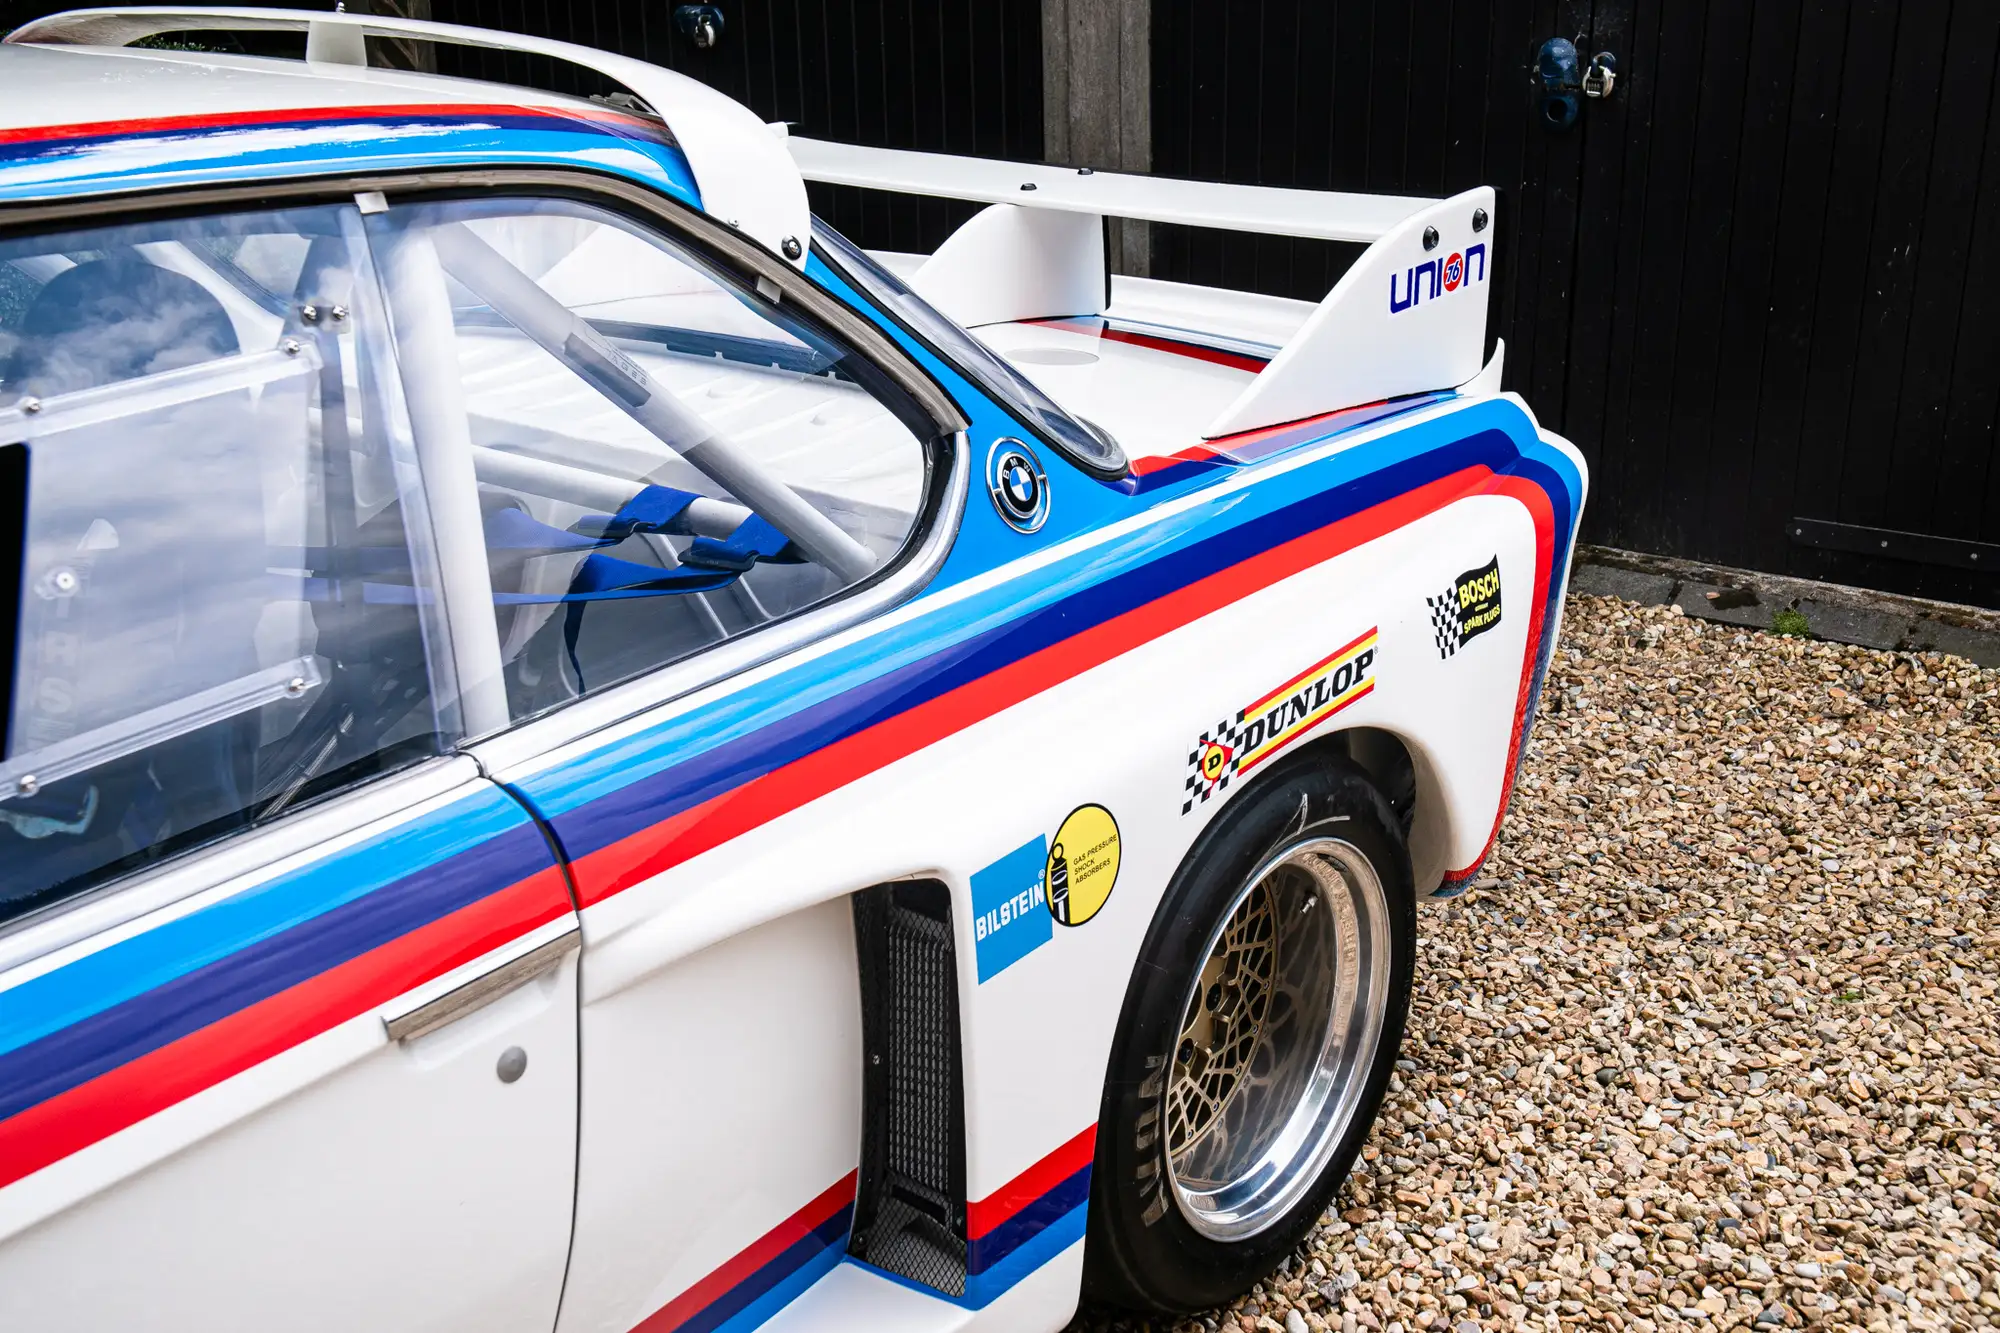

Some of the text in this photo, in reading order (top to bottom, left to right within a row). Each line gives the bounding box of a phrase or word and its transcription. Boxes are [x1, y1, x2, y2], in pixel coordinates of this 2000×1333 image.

[1445, 259, 1461, 285] 76
[1003, 457, 1031, 480] BMW
[1458, 567, 1499, 609] BOSCH
[1464, 614, 1483, 635] SPARK
[1483, 603, 1501, 625] PLUGS
[1240, 647, 1374, 756] DUNLOP
[1207, 753, 1222, 772] D
[1073, 834, 1118, 866] GAS PRESSURE
[1074, 857, 1096, 876] SHOCK
[1075, 857, 1112, 884] ABSORBERS
[975, 880, 1046, 942] BILSTEIN
